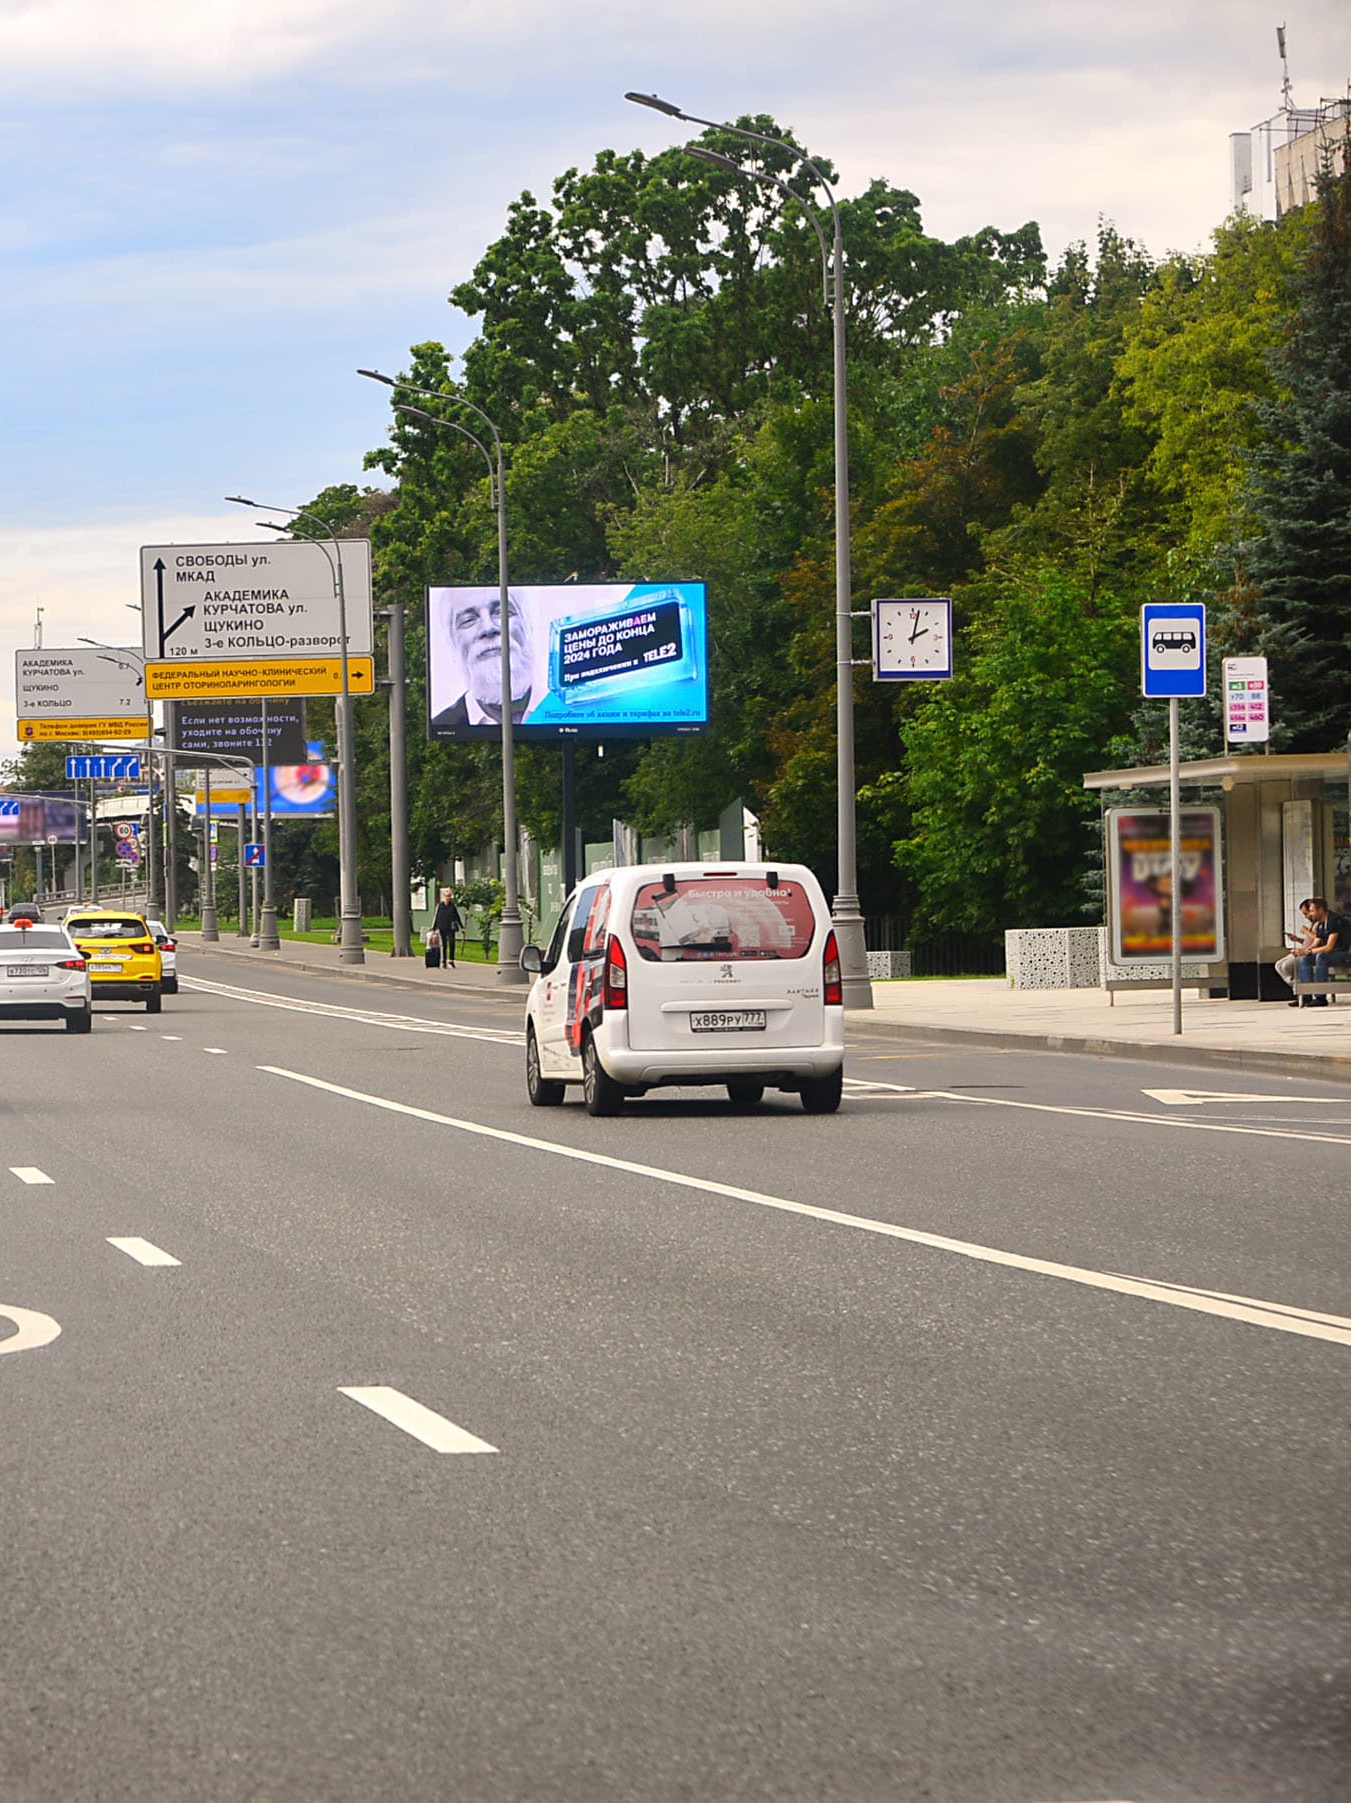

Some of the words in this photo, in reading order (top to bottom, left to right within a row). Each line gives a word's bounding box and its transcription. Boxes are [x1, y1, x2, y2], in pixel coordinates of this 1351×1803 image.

[175, 555, 247, 567] СВОБОДЫ
[251, 556, 271, 568] ул.
[176, 570, 215, 583] МКАД
[204, 589, 289, 602] АКАДЕМИКА
[203, 603, 284, 616] КУРЧАТОВА
[288, 604, 308, 616] ул.
[204, 619, 264, 633] ЩУКИНО
[564, 612, 656, 643] ЗАМОРАЖИВАЕМ
[204, 637, 224, 648] 3-е
[564, 639, 597, 655] ЦЕНЫ
[598, 633, 615, 648] ДО
[616, 624, 655, 642] КОНЦА
[170, 647, 187, 656] 120
[564, 651, 590, 665] 2024
[592, 642, 623, 658] ГОДА
[643, 642, 677, 663] TELE2
[23, 659, 73, 667] АКАДЕМИКА
[23, 668, 70, 677] КУРЧАТОВА
[152, 670, 220, 680] ФЕДЕРАЛЬНЫЙ
[222, 666, 327, 678] НАУЧНО-КЛИНИЧЕСКИЙ
[23, 684, 59, 692] ЩУКИНО
[152, 682, 181, 691] ЦЕНТР
[183, 679, 296, 690] ОТОРИНОЛАРИНГОЛОГИИ
[37, 699, 72, 707] КОЛЬЦО
[181, 715, 206, 725] Если
[208, 716, 227, 724] нет
[181, 729, 222, 738] уходите
[182, 741, 210, 749] сами,
[213, 740, 252, 748] звоните
[688, 889, 732, 900] Быстро
[744, 1012, 761, 1022] 777
